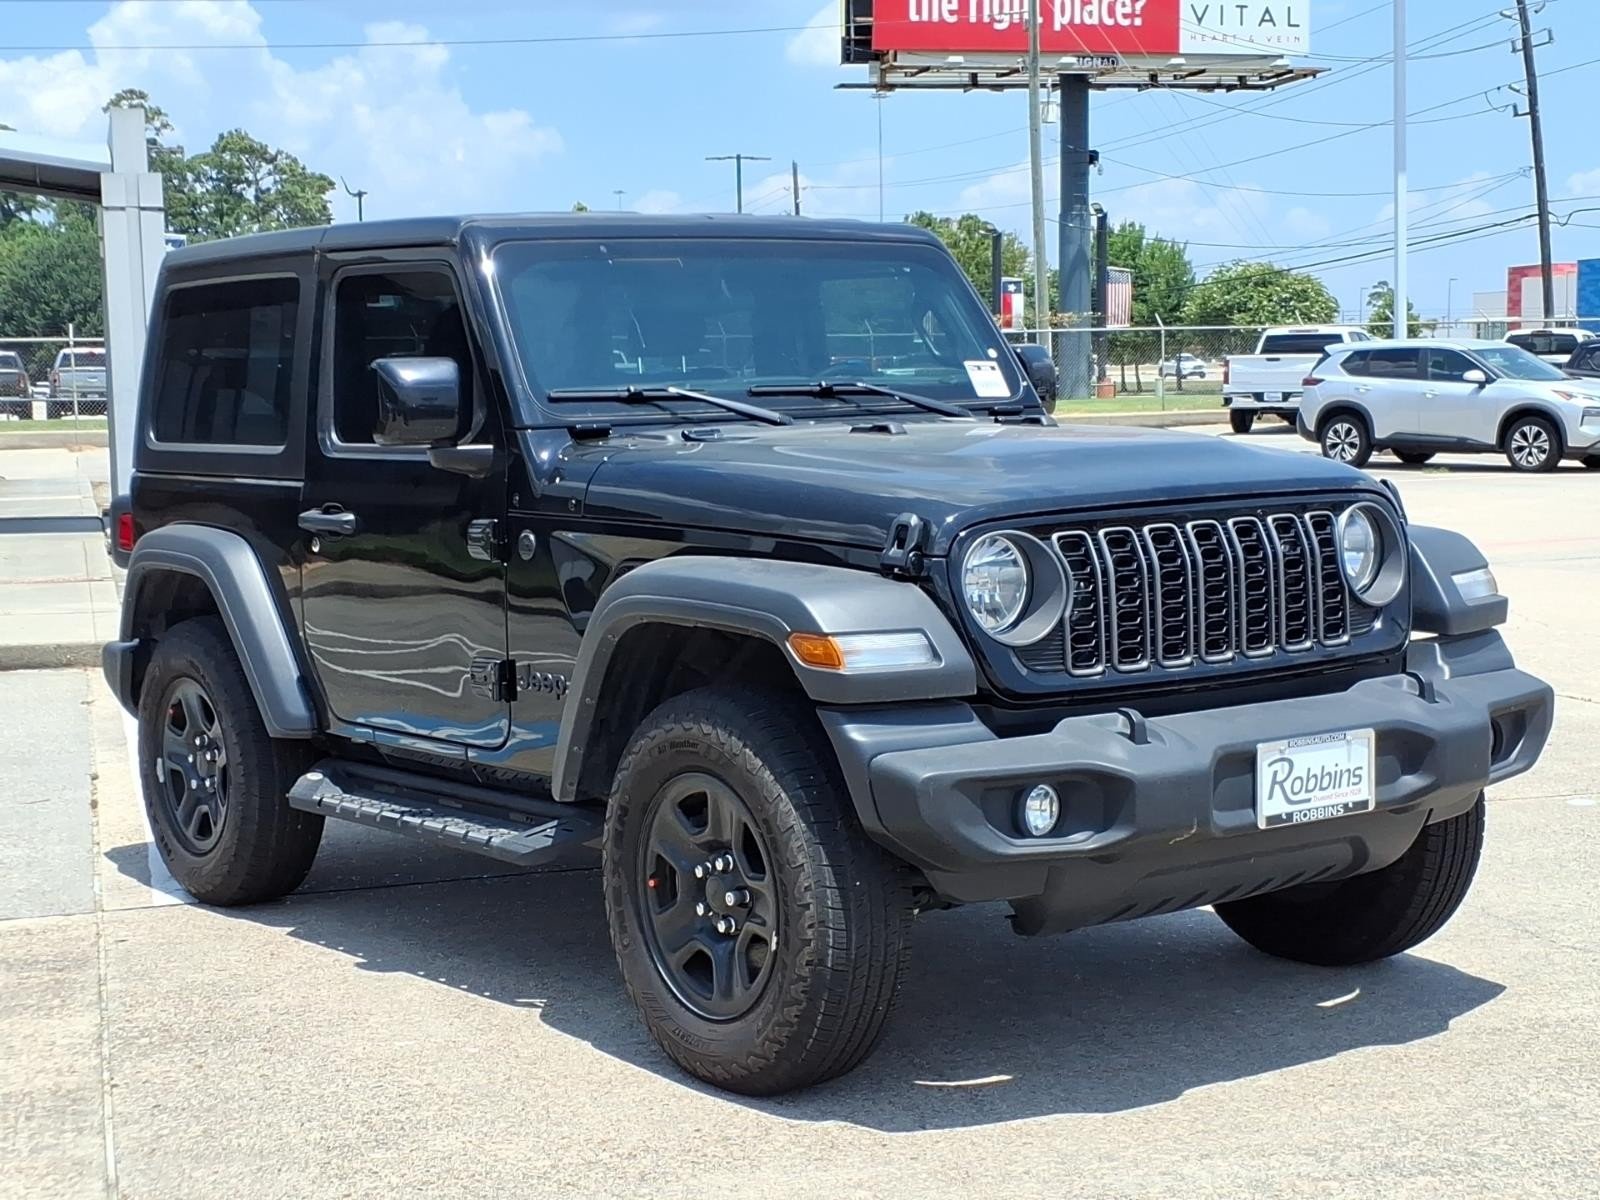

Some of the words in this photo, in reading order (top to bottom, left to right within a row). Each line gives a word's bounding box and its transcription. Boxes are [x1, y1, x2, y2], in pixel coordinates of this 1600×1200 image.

[1053, 0, 1148, 31] place?
[1191, 4, 1300, 27] VITAL
[1190, 33, 1237, 42] HEART
[518, 664, 567, 700] Jeep
[1267, 757, 1363, 805] Robbins
[1293, 804, 1345, 823] ROBBINS
